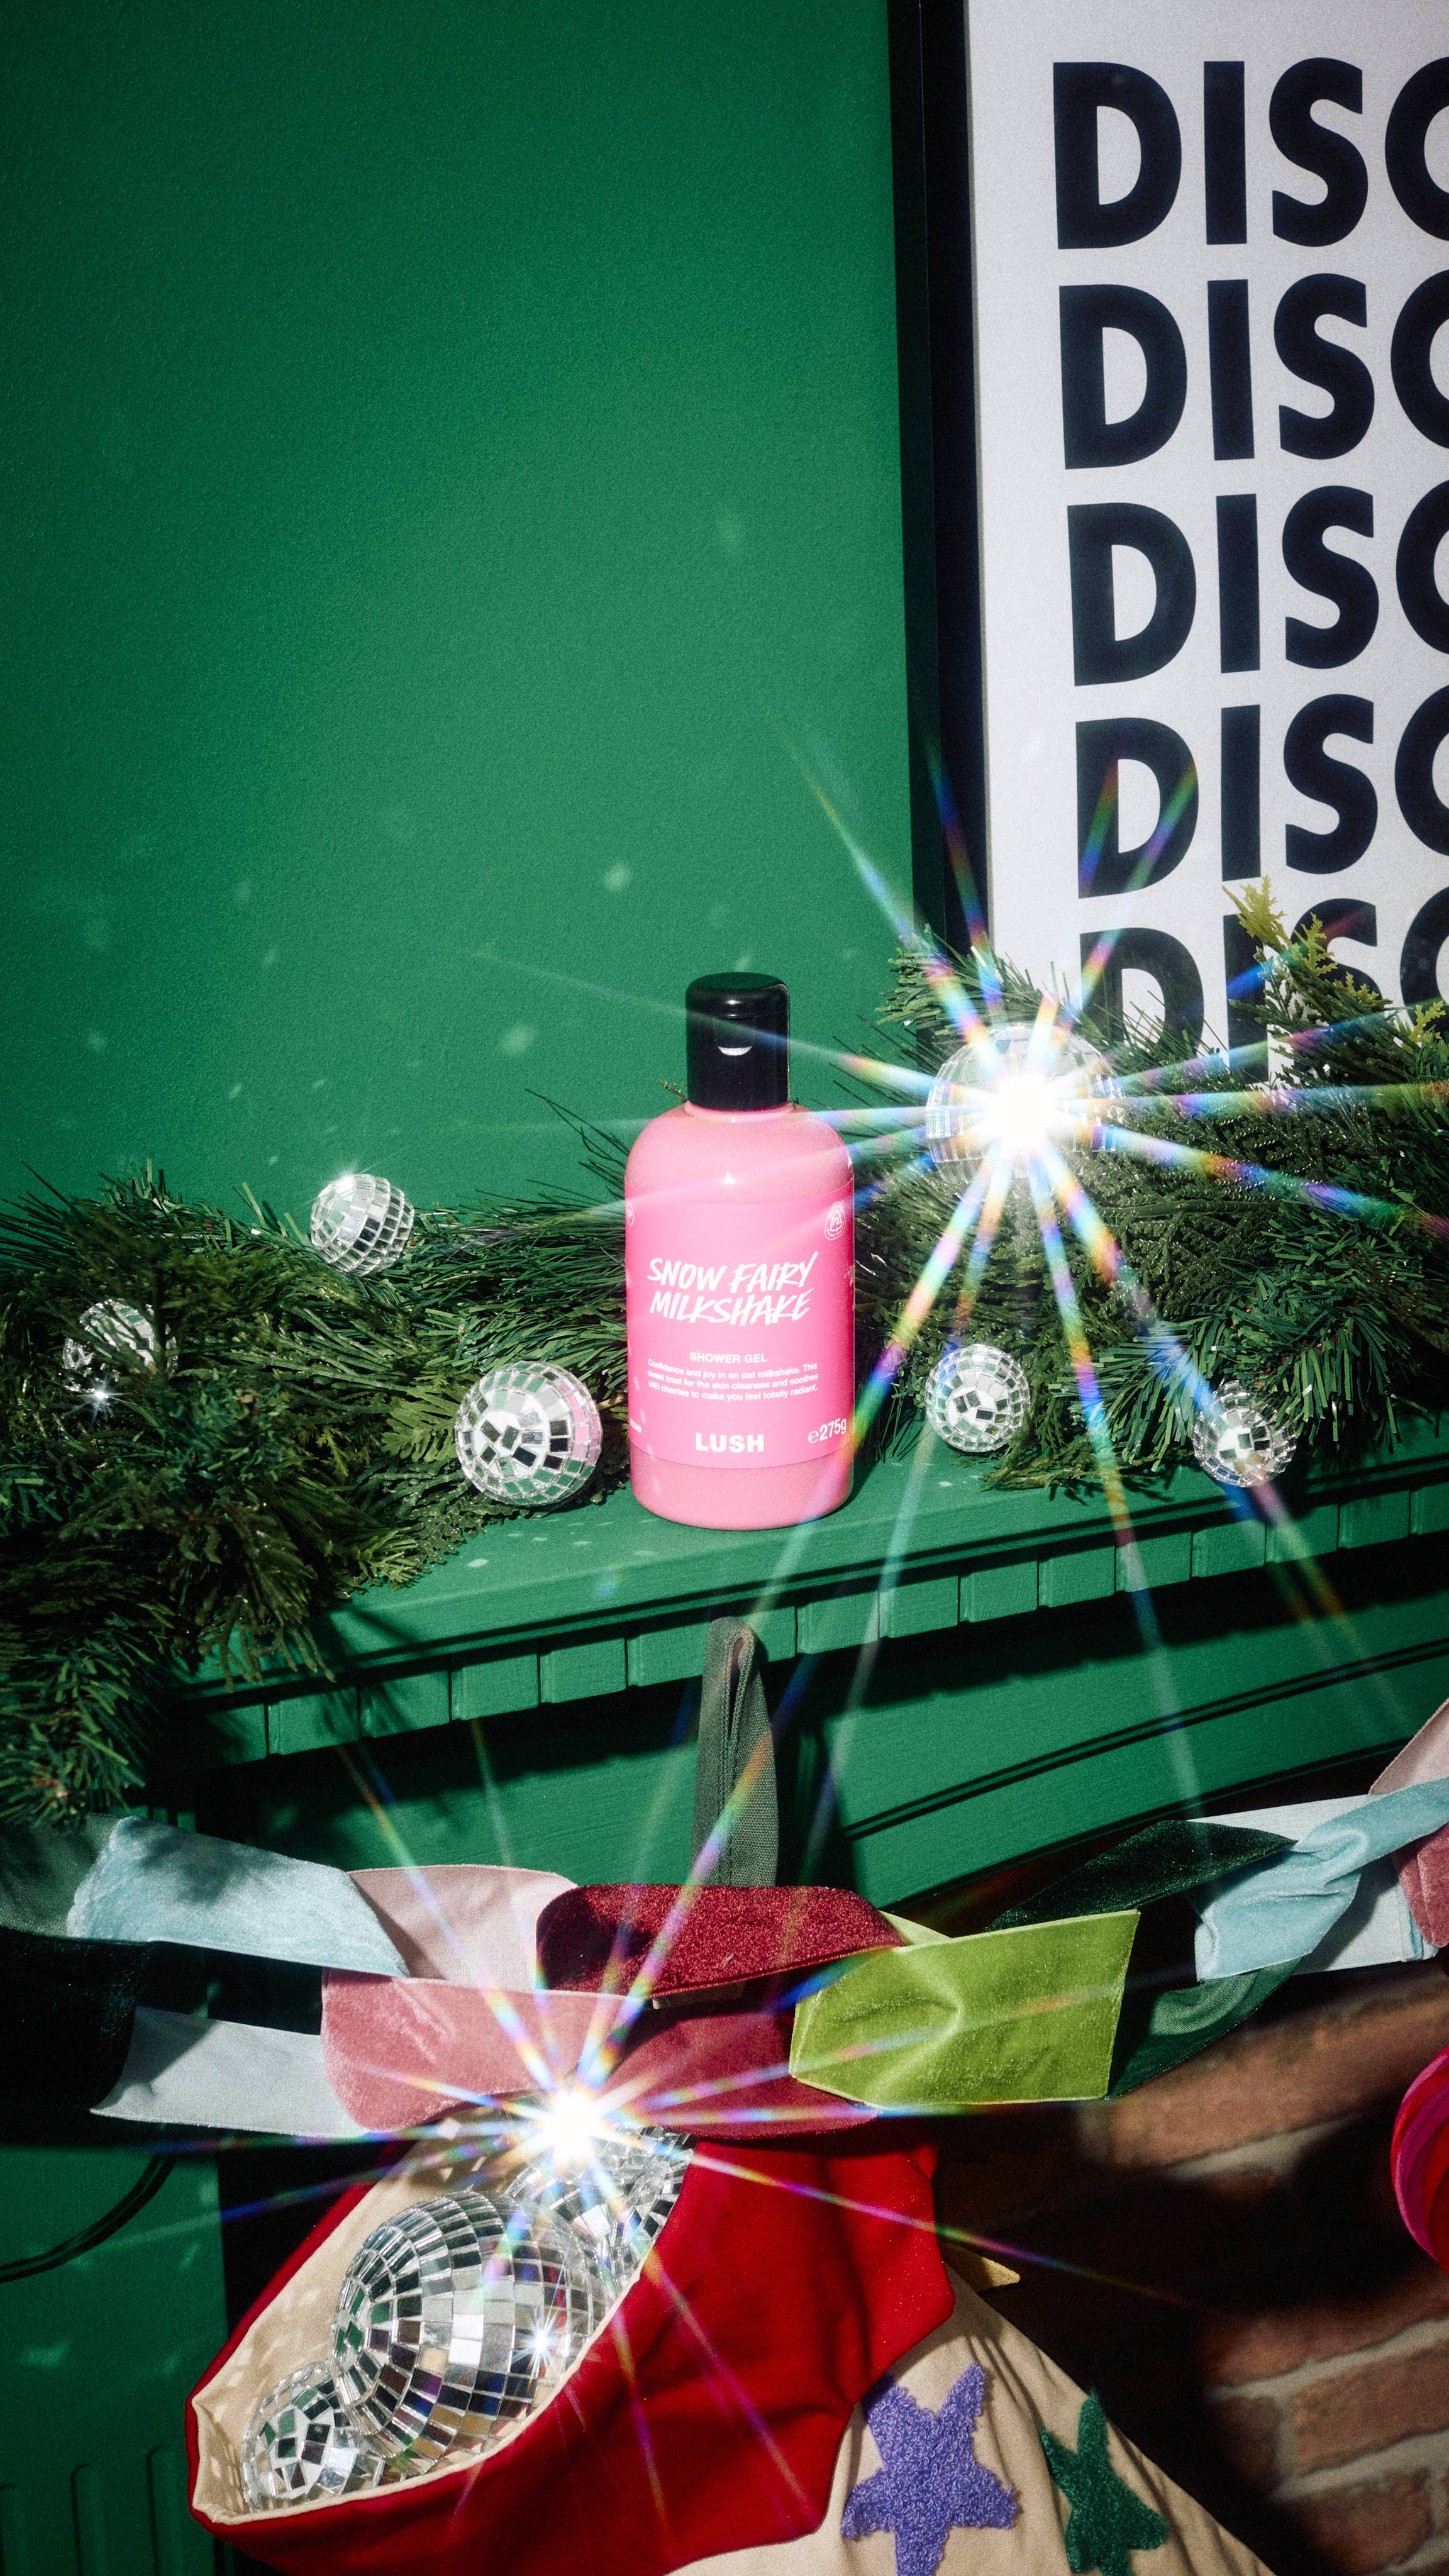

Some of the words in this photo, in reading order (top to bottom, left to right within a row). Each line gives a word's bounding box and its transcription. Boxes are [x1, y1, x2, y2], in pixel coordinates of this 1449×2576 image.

[1080, 887, 1449, 1084] DIS
[647, 1258, 728, 1291] SNOW
[729, 1252, 819, 1294] FAIRY
[649, 1288, 815, 1326] MILKSHAKE
[690, 1352, 740, 1363] SHOWER
[744, 1353, 768, 1363] GEL
[647, 1370, 665, 1381] sweet
[665, 1375, 682, 1385] treat
[684, 1378, 695, 1387] for
[696, 1380, 710, 1389] the
[712, 1381, 730, 1389] skin
[731, 1382, 770, 1390] cleanses
[772, 1379, 788, 1388] and
[789, 1374, 819, 1385] soothes
[648, 1358, 684, 1375] Confidence
[686, 1369, 701, 1377] and
[703, 1370, 716, 1380] joy
[718, 1371, 726, 1379] in
[741, 1371, 755, 1379] oat
[758, 1367, 801, 1379] milkshake.
[802, 1362, 818, 1372] This
[648, 1380, 660, 1391] with
[660, 1384, 690, 1397] cherries
[691, 1391, 699, 1399] to
[701, 1392, 725, 1401] make
[726, 1393, 743, 1402] you
[745, 1392, 761, 1401] feel
[763, 1389, 789, 1399] totally
[791, 1384, 818, 1396] radiant.
[696, 1433, 764, 1453] LUSH
